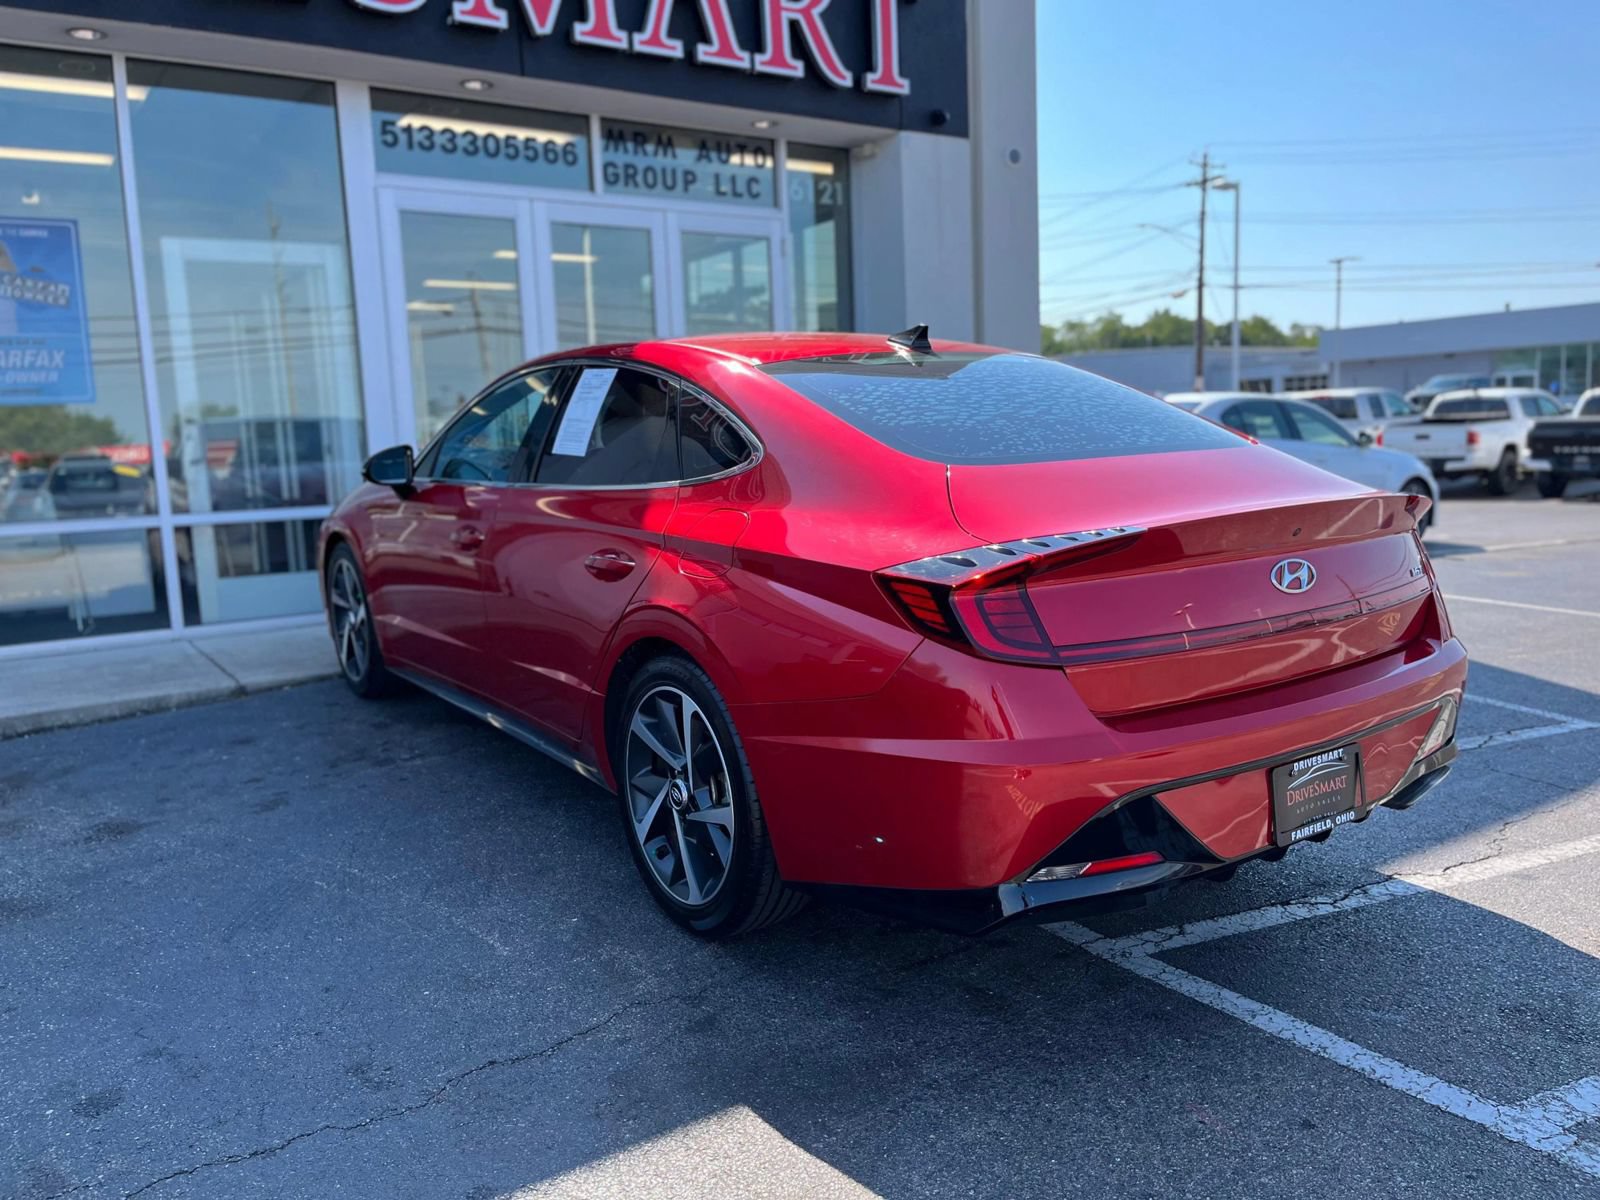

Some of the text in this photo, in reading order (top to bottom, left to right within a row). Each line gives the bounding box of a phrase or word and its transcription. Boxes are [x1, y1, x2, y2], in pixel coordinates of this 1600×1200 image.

[381, 120, 578, 166] 5133305566
[604, 129, 768, 168] MRM AUTO
[603, 162, 762, 199] GROUP LLC
[1293, 748, 1344, 771] DRIVESMART
[1291, 819, 1334, 841] FAIRFIELD,
[1335, 811, 1355, 825] OHIO
